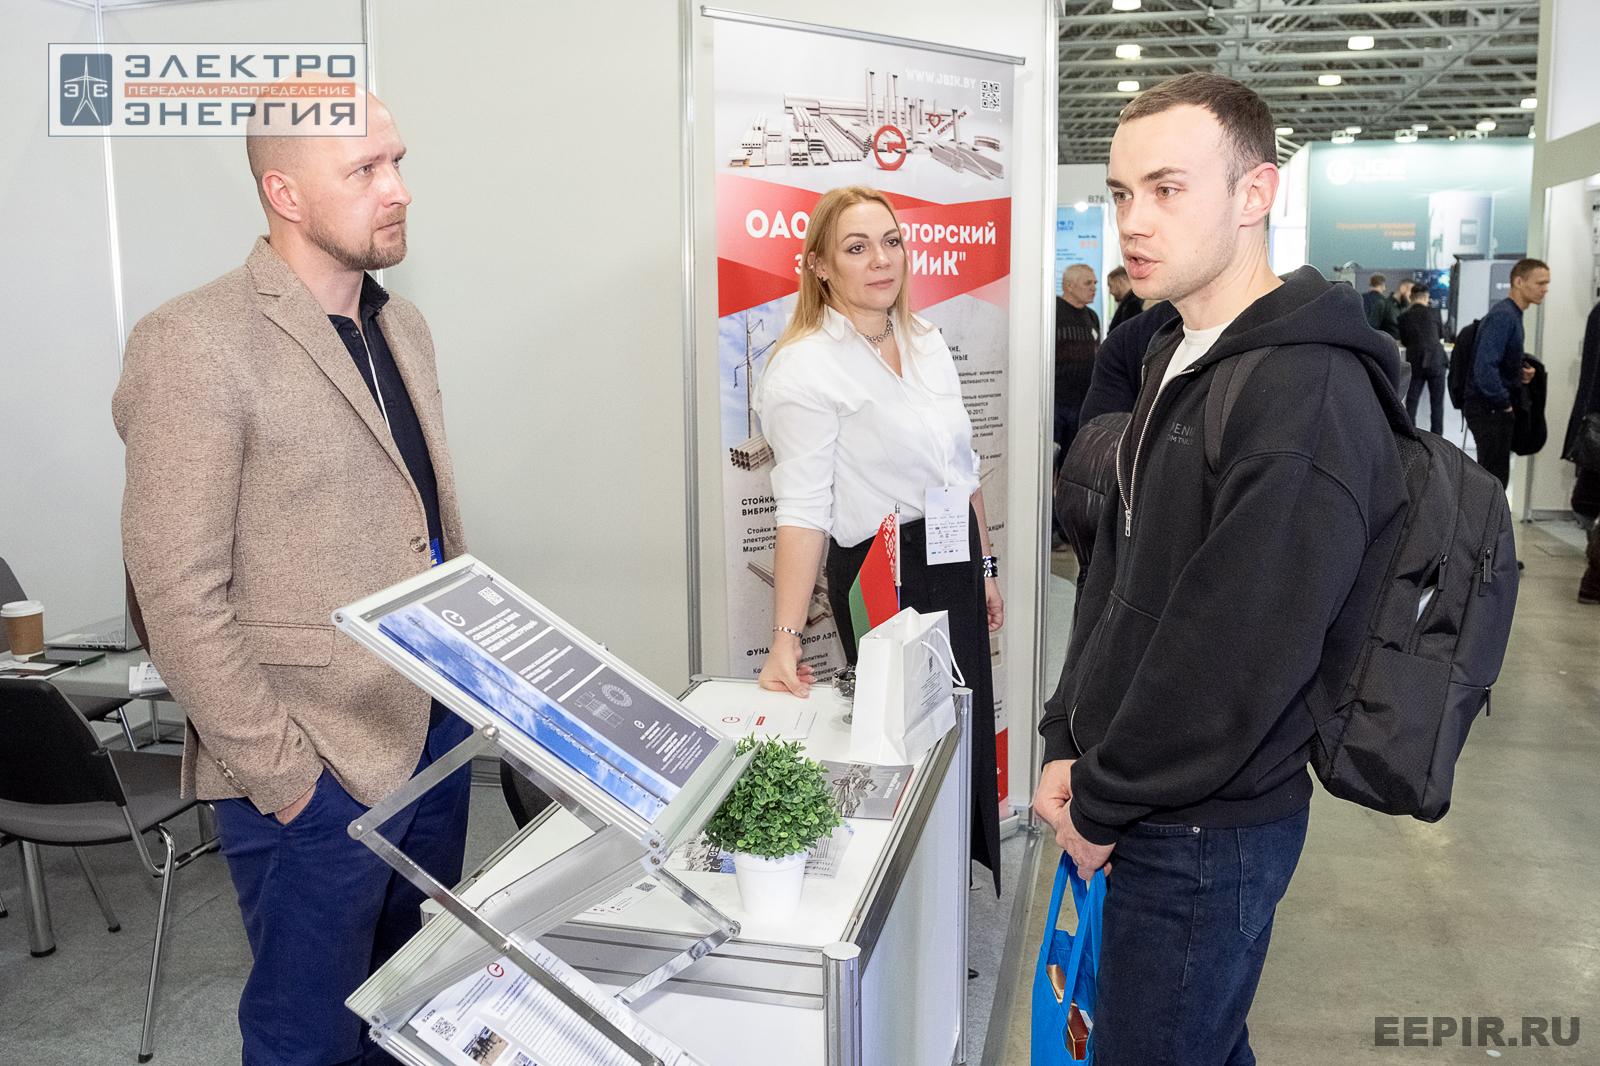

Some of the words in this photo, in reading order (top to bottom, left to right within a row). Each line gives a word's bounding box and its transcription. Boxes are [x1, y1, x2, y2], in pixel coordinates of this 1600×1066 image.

[745, 209, 810, 240] ОАО
[900, 221, 996, 245] ОГОРСКИЙ
[907, 250, 967, 276] ИиК"
[746, 647, 770, 656] ФУНД
